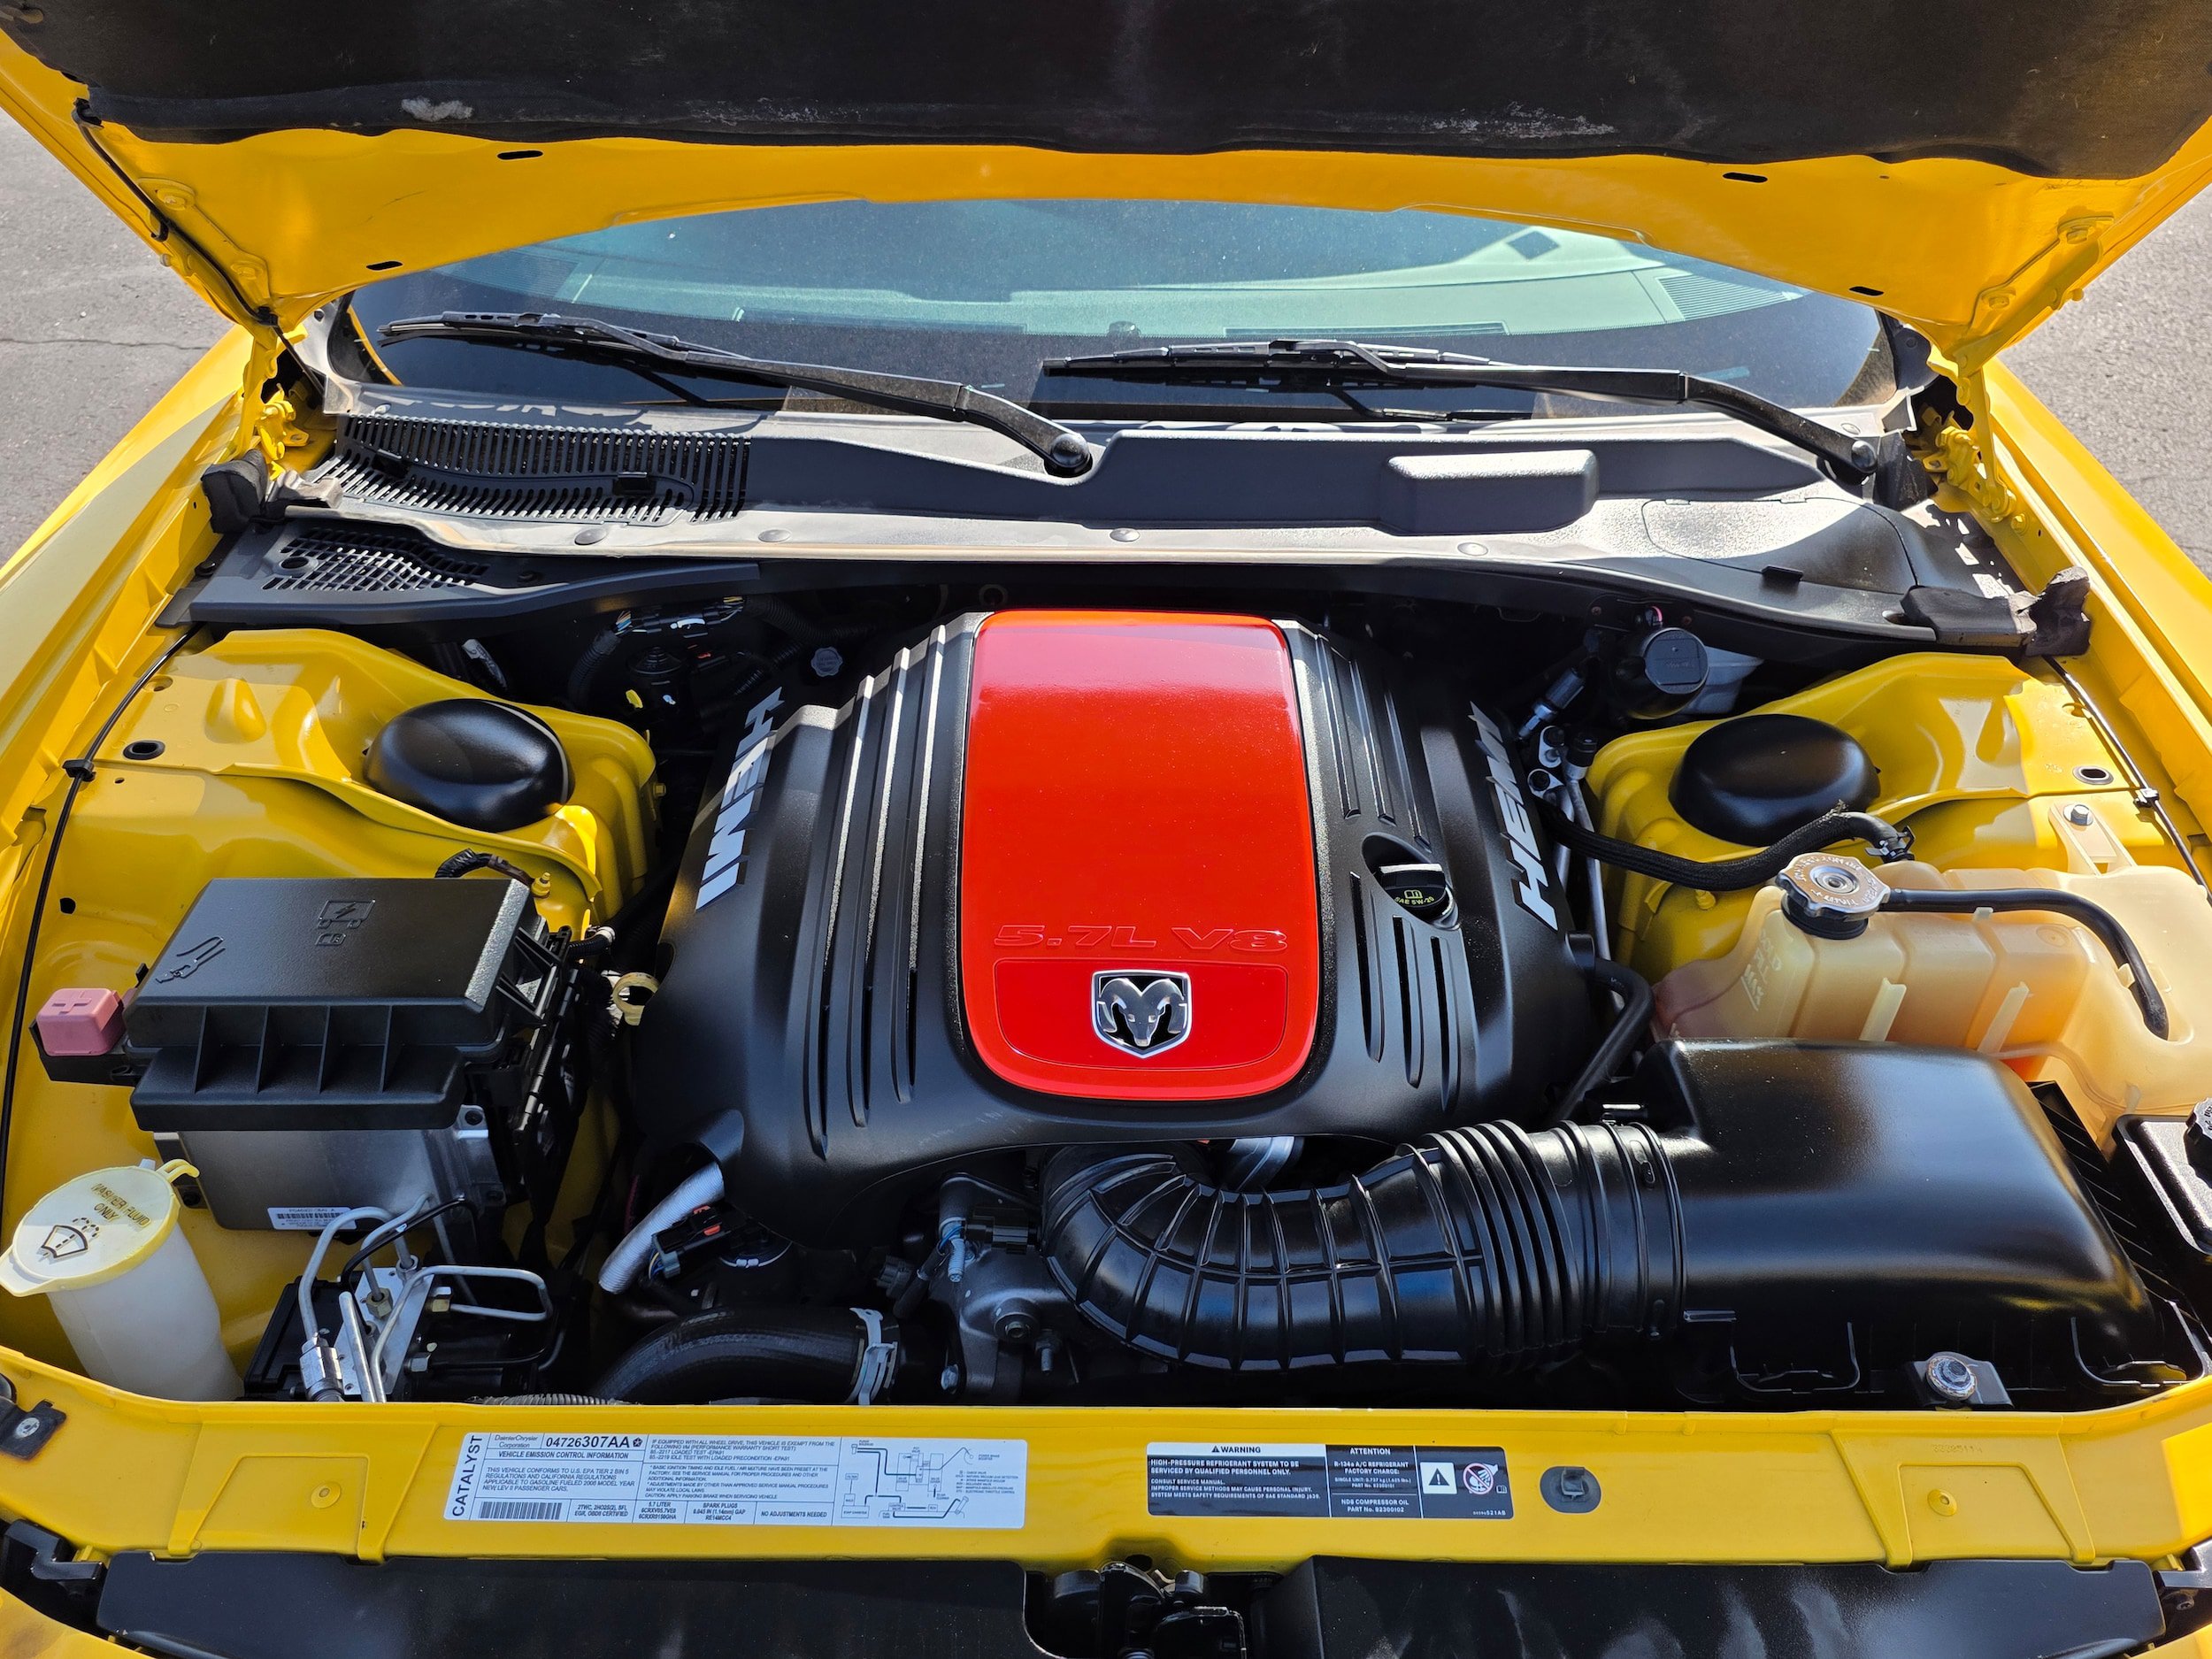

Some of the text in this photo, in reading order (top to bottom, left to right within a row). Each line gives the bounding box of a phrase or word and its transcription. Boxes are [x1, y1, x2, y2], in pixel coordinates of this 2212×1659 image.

[695, 687, 785, 911] HEMI
[1468, 701, 1558, 931] HEMI
[994, 925, 1287, 952] 5.7L V8
[94, 1203, 119, 1220] ONLY
[546, 1435, 630, 1448] 04726307AA
[452, 1435, 483, 1517] CATALYST
